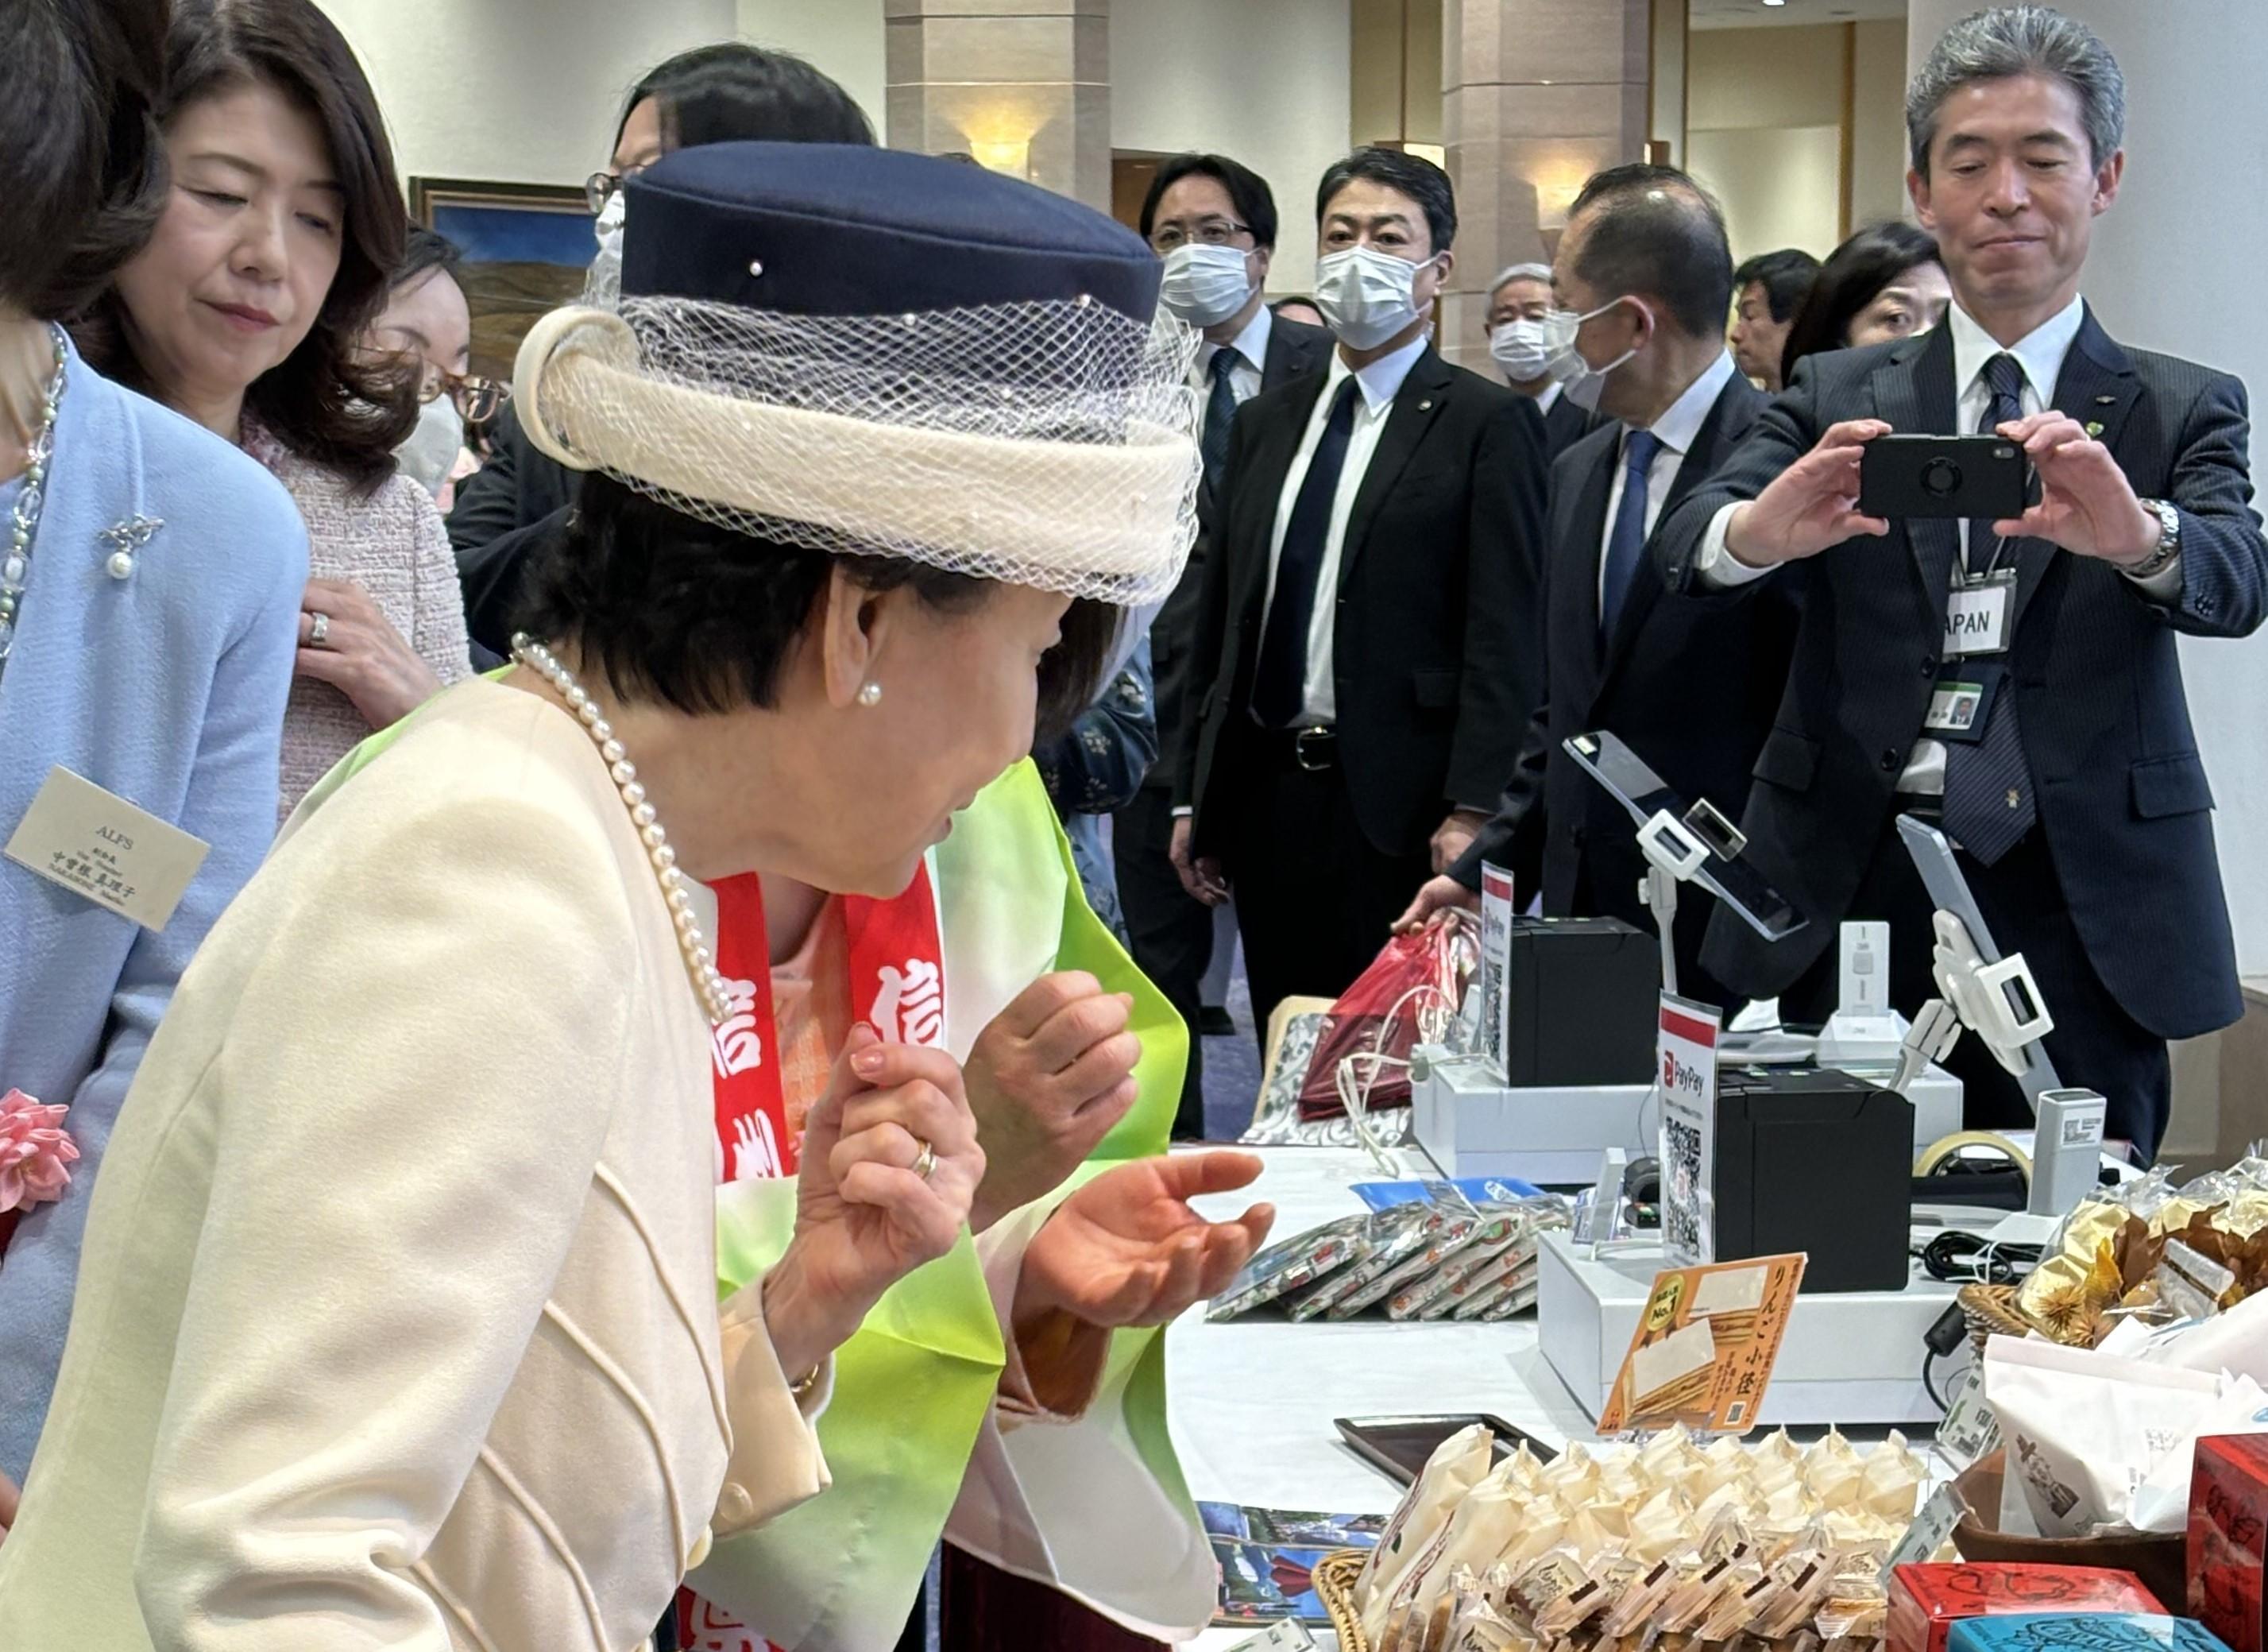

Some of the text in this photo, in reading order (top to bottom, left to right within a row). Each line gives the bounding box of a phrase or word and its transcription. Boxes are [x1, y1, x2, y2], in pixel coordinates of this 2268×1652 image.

[95, 826, 133, 850] ALFS
[1675, 1060, 1705, 1097] PayPay
[1652, 1295, 1677, 1321] No.1
